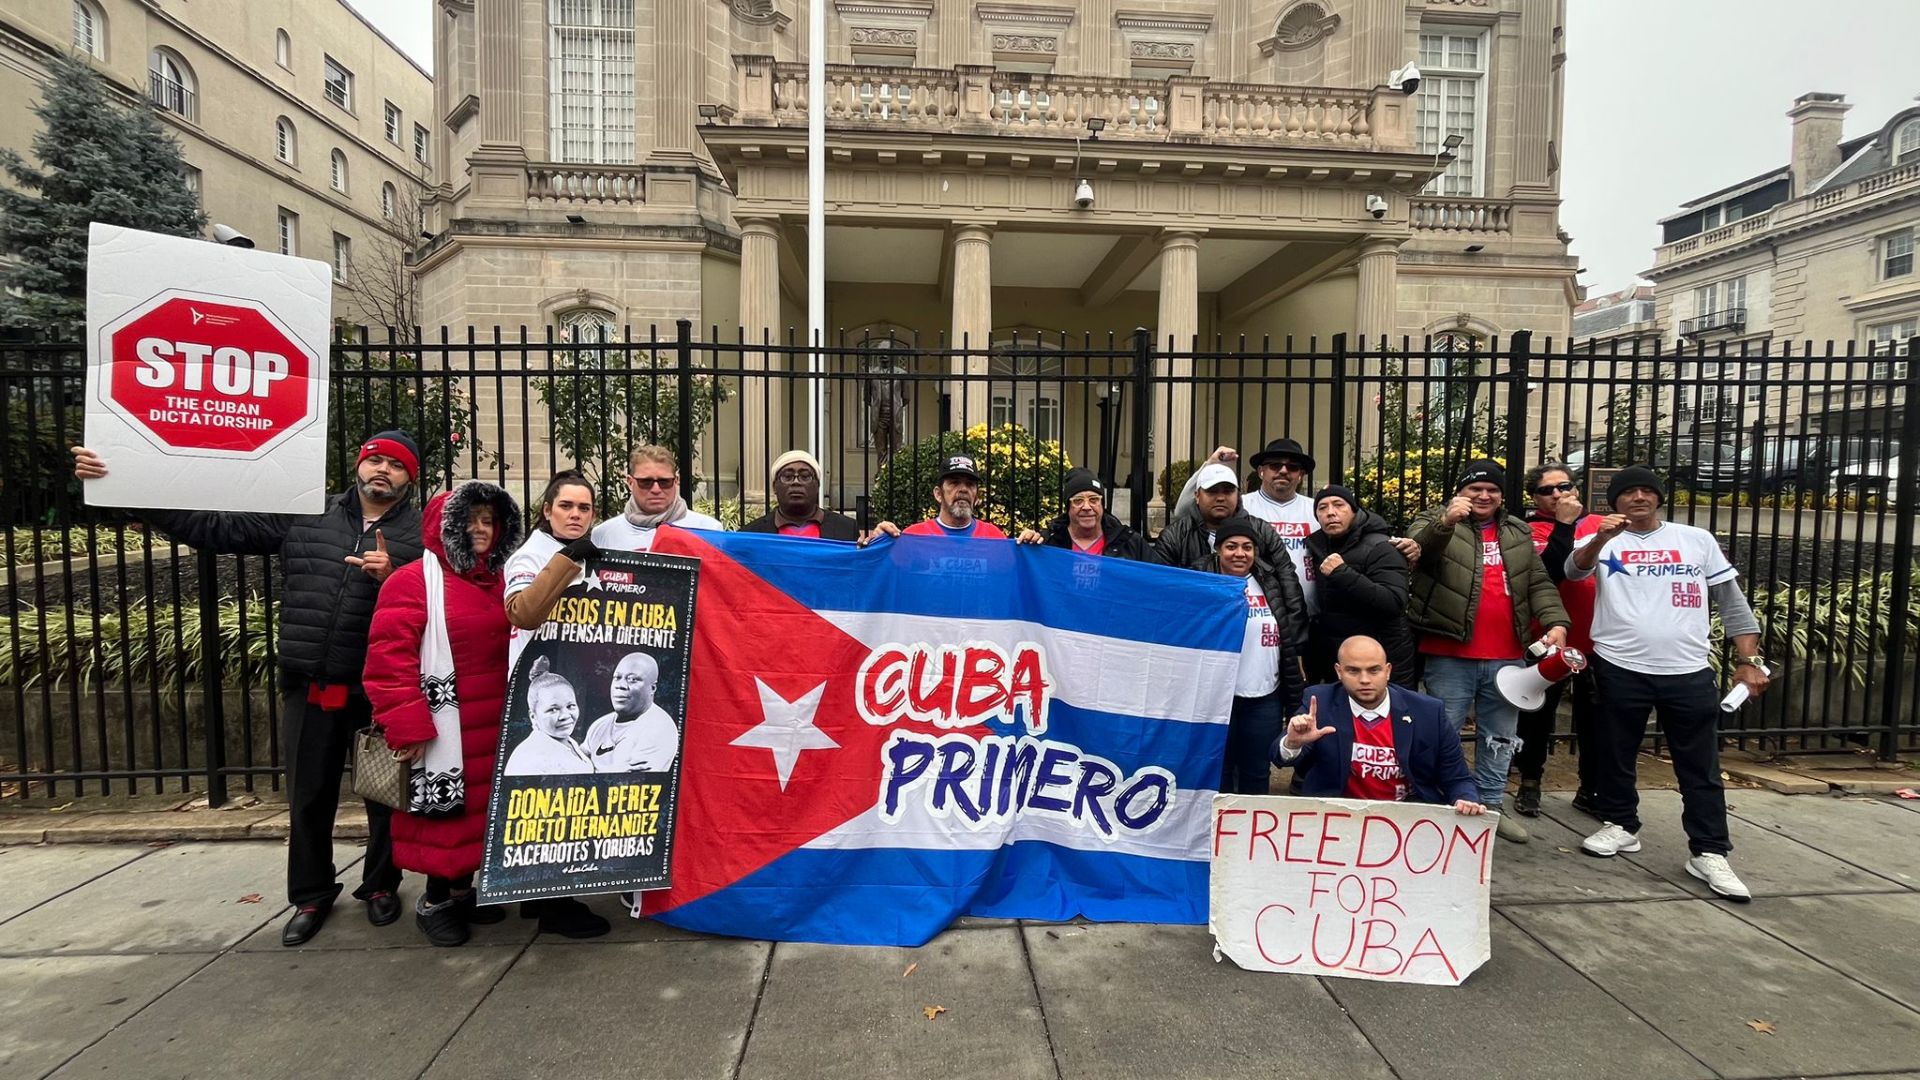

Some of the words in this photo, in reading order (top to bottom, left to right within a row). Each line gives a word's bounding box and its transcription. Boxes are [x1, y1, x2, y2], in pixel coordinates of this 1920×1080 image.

[135, 337, 289, 398] STOP
[165, 396, 199, 411] THE
[203, 401, 260, 416] CUBAN
[150, 409, 273, 431] DICTATORSHIP
[1628, 551, 1673, 564] CUBA
[603, 571, 629, 583] CUBA
[1636, 564, 1701, 577] PRIMERO
[606, 582, 646, 595] PRIMERO
[1672, 582, 1685, 594] EL
[1672, 594, 1702, 608] CERO
[605, 602, 627, 627] EN
[630, 603, 677, 631] CUBA
[561, 624, 613, 644] PENSAR
[616, 626, 676, 649] DIFERENTE
[1261, 634, 1280, 647] CER
[862, 646, 1050, 730] CUBA
[1356, 747, 1398, 763] CUBA
[883, 736, 1170, 836] PRIMERO
[507, 786, 600, 820] DONAIDA
[606, 785, 662, 814] PEREZ
[503, 818, 567, 846] LORETO
[570, 812, 658, 841] HERNANDEZ
[502, 838, 589, 868] SACERDOTES
[593, 836, 655, 861] YORUBAS
[1214, 808, 1490, 884] FREEDOM
[1307, 871, 1406, 917] FOR
[1255, 904, 1459, 981] CUBA
